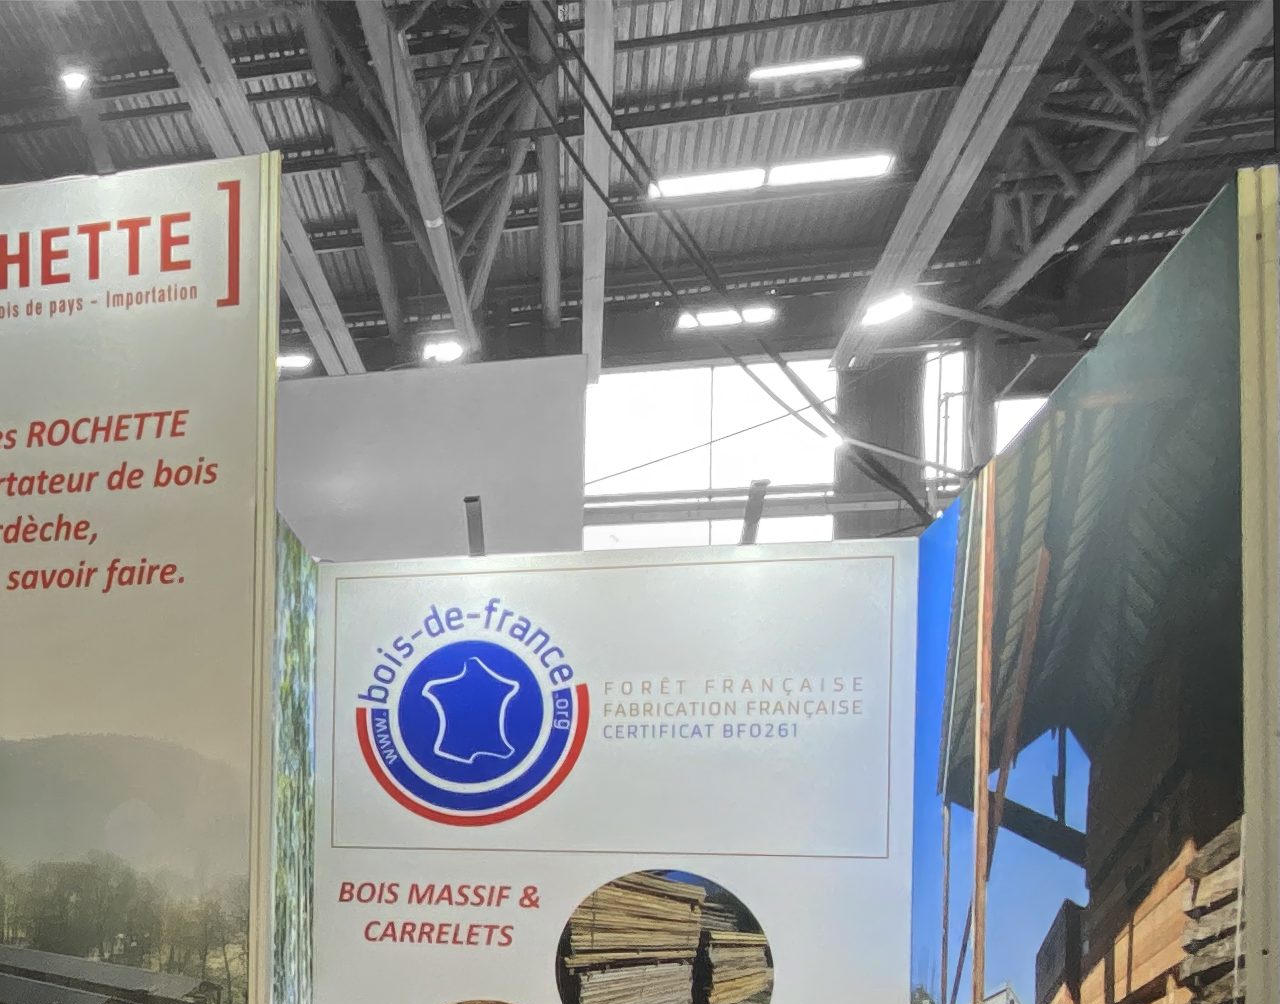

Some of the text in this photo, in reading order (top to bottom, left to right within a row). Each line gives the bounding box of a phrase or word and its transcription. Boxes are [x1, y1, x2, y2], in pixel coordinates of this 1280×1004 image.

[26, 299, 42, 316] de
[50, 298, 83, 318] pays
[107, 284, 197, 310] Importation
[27, 410, 189, 448] ROCHETTE
[107, 461, 144, 490] de
[154, 457, 218, 487] bois
[6, 561, 98, 590] savoir
[102, 558, 184, 593] faire.
[605, 677, 863, 696] FORÊT FRANÇAISE
[604, 700, 863, 718] FABRICATION FRANÇAISE
[603, 724, 714, 739] CERTIFICAT
[338, 882, 539, 908] BOIS MASSIF &
[364, 921, 514, 946] CARRELETS
